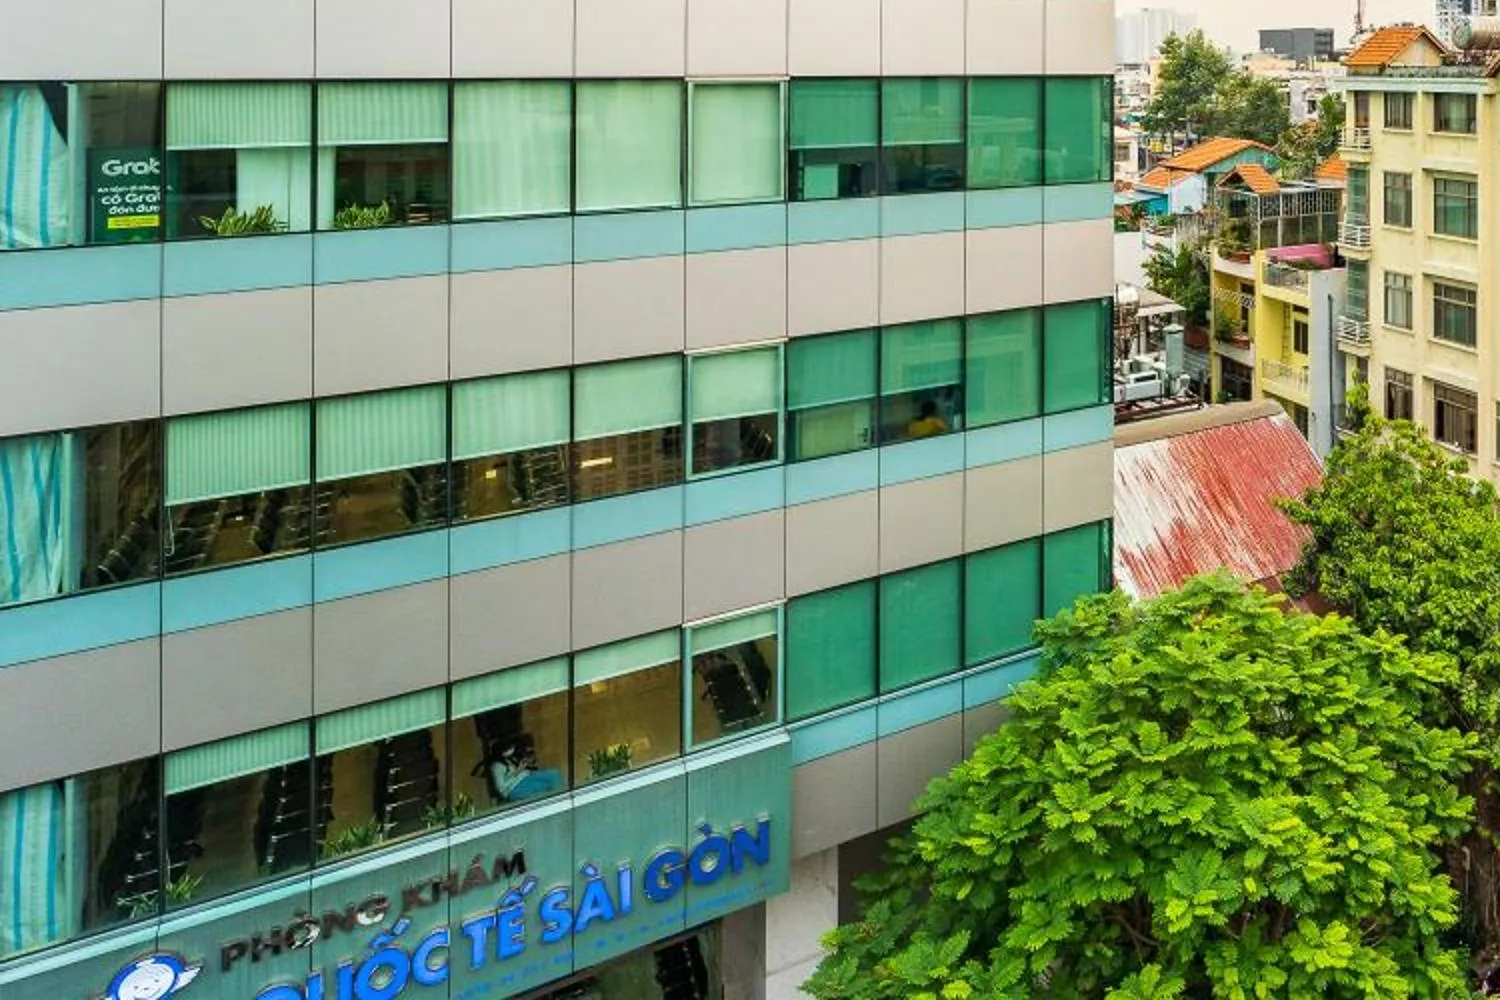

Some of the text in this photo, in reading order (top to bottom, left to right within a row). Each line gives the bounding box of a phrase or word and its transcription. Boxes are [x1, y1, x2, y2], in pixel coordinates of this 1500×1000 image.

[220, 848, 527, 971] PHÒNG KHÁM
[461, 875, 539, 971] TẾ
[538, 859, 633, 944] SÀI
[644, 817, 771, 904] GÒN
